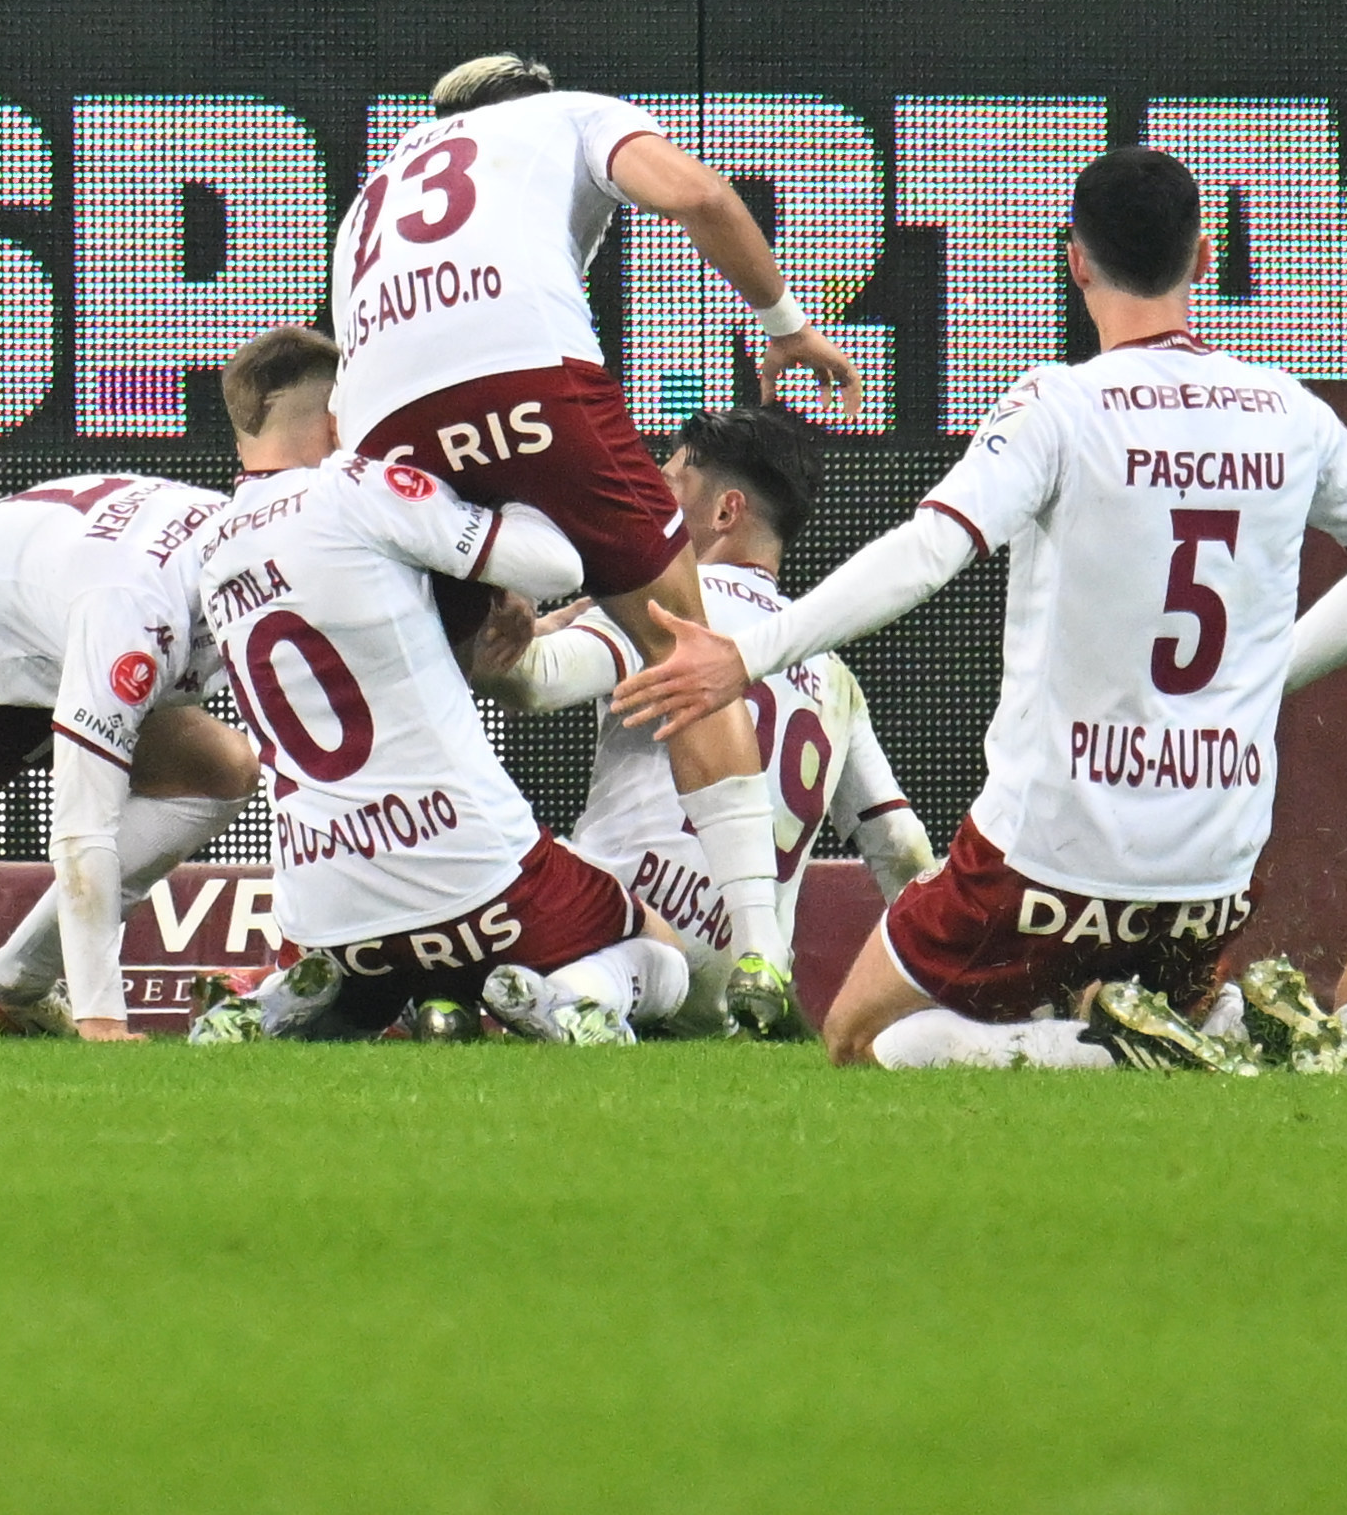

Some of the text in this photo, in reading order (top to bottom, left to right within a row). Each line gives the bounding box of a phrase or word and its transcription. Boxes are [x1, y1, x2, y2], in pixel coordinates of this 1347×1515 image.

[350, 137, 478, 296] 23
[1101, 384, 1288, 415] MOBEXPERT
[1126, 449, 1285, 498] PAȘCANU
[208, 559, 292, 630] ETRILA
[1150, 509, 1241, 696] 5
